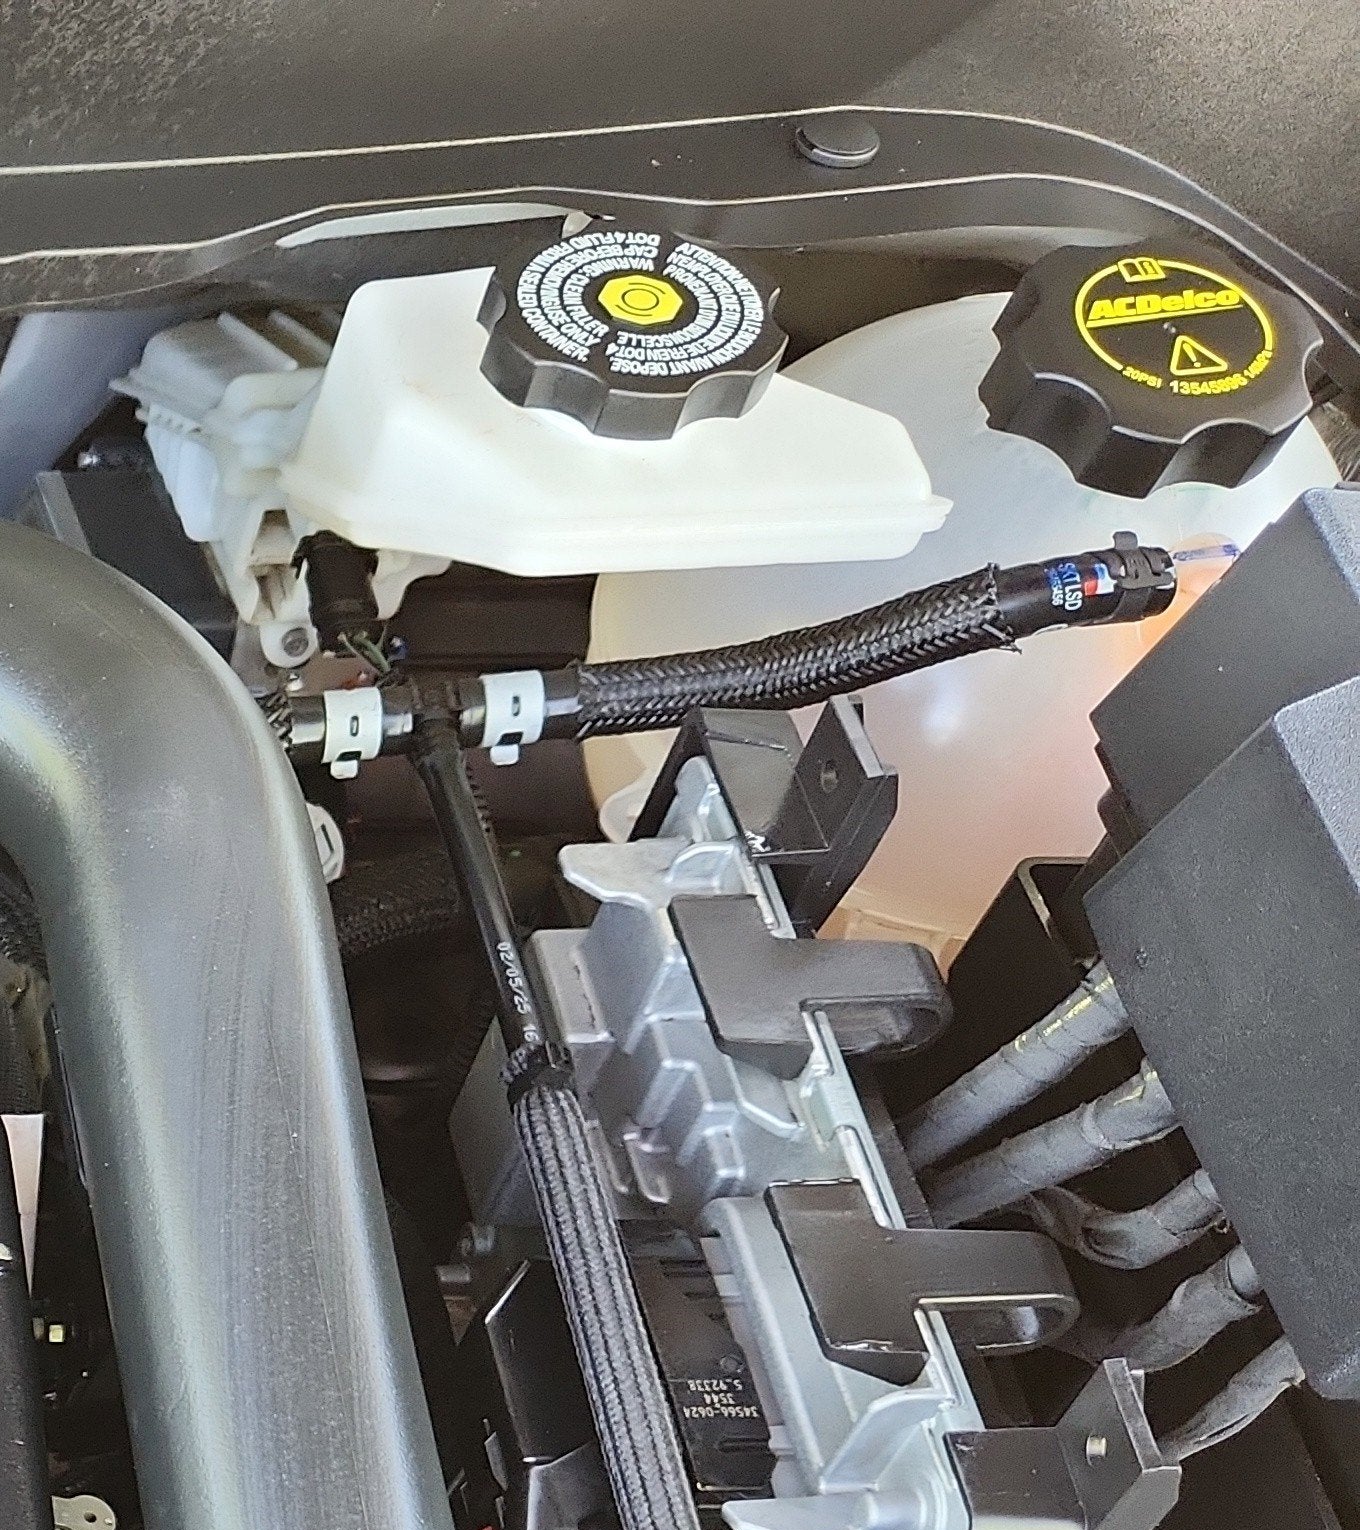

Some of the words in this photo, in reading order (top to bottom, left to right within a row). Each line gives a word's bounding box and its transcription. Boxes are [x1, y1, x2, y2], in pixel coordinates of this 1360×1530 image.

[569, 232, 618, 250] FLUID
[613, 231, 629, 245] 4
[625, 231, 661, 249] DOT
[532, 241, 575, 270] FROM
[564, 244, 625, 268] BEFORE
[623, 245, 659, 259] CAP
[525, 261, 547, 275] A
[577, 257, 655, 278] WARNING:
[517, 271, 543, 308] SEALED
[563, 273, 590, 305] CLEAN
[1088, 289, 1240, 320] ACDelco
[542, 305, 572, 327] USE
[565, 305, 610, 337] FILLER
[719, 310, 741, 326] DU
[560, 322, 601, 347] ONLY
[740, 319, 762, 335] LE
[605, 342, 620, 360] 4
[614, 345, 646, 361] DOT
[645, 346, 693, 362] FREIN
[681, 341, 708, 357] DE
[665, 354, 718, 376] AVANT
[497, 941, 532, 1015] 02/05/25
